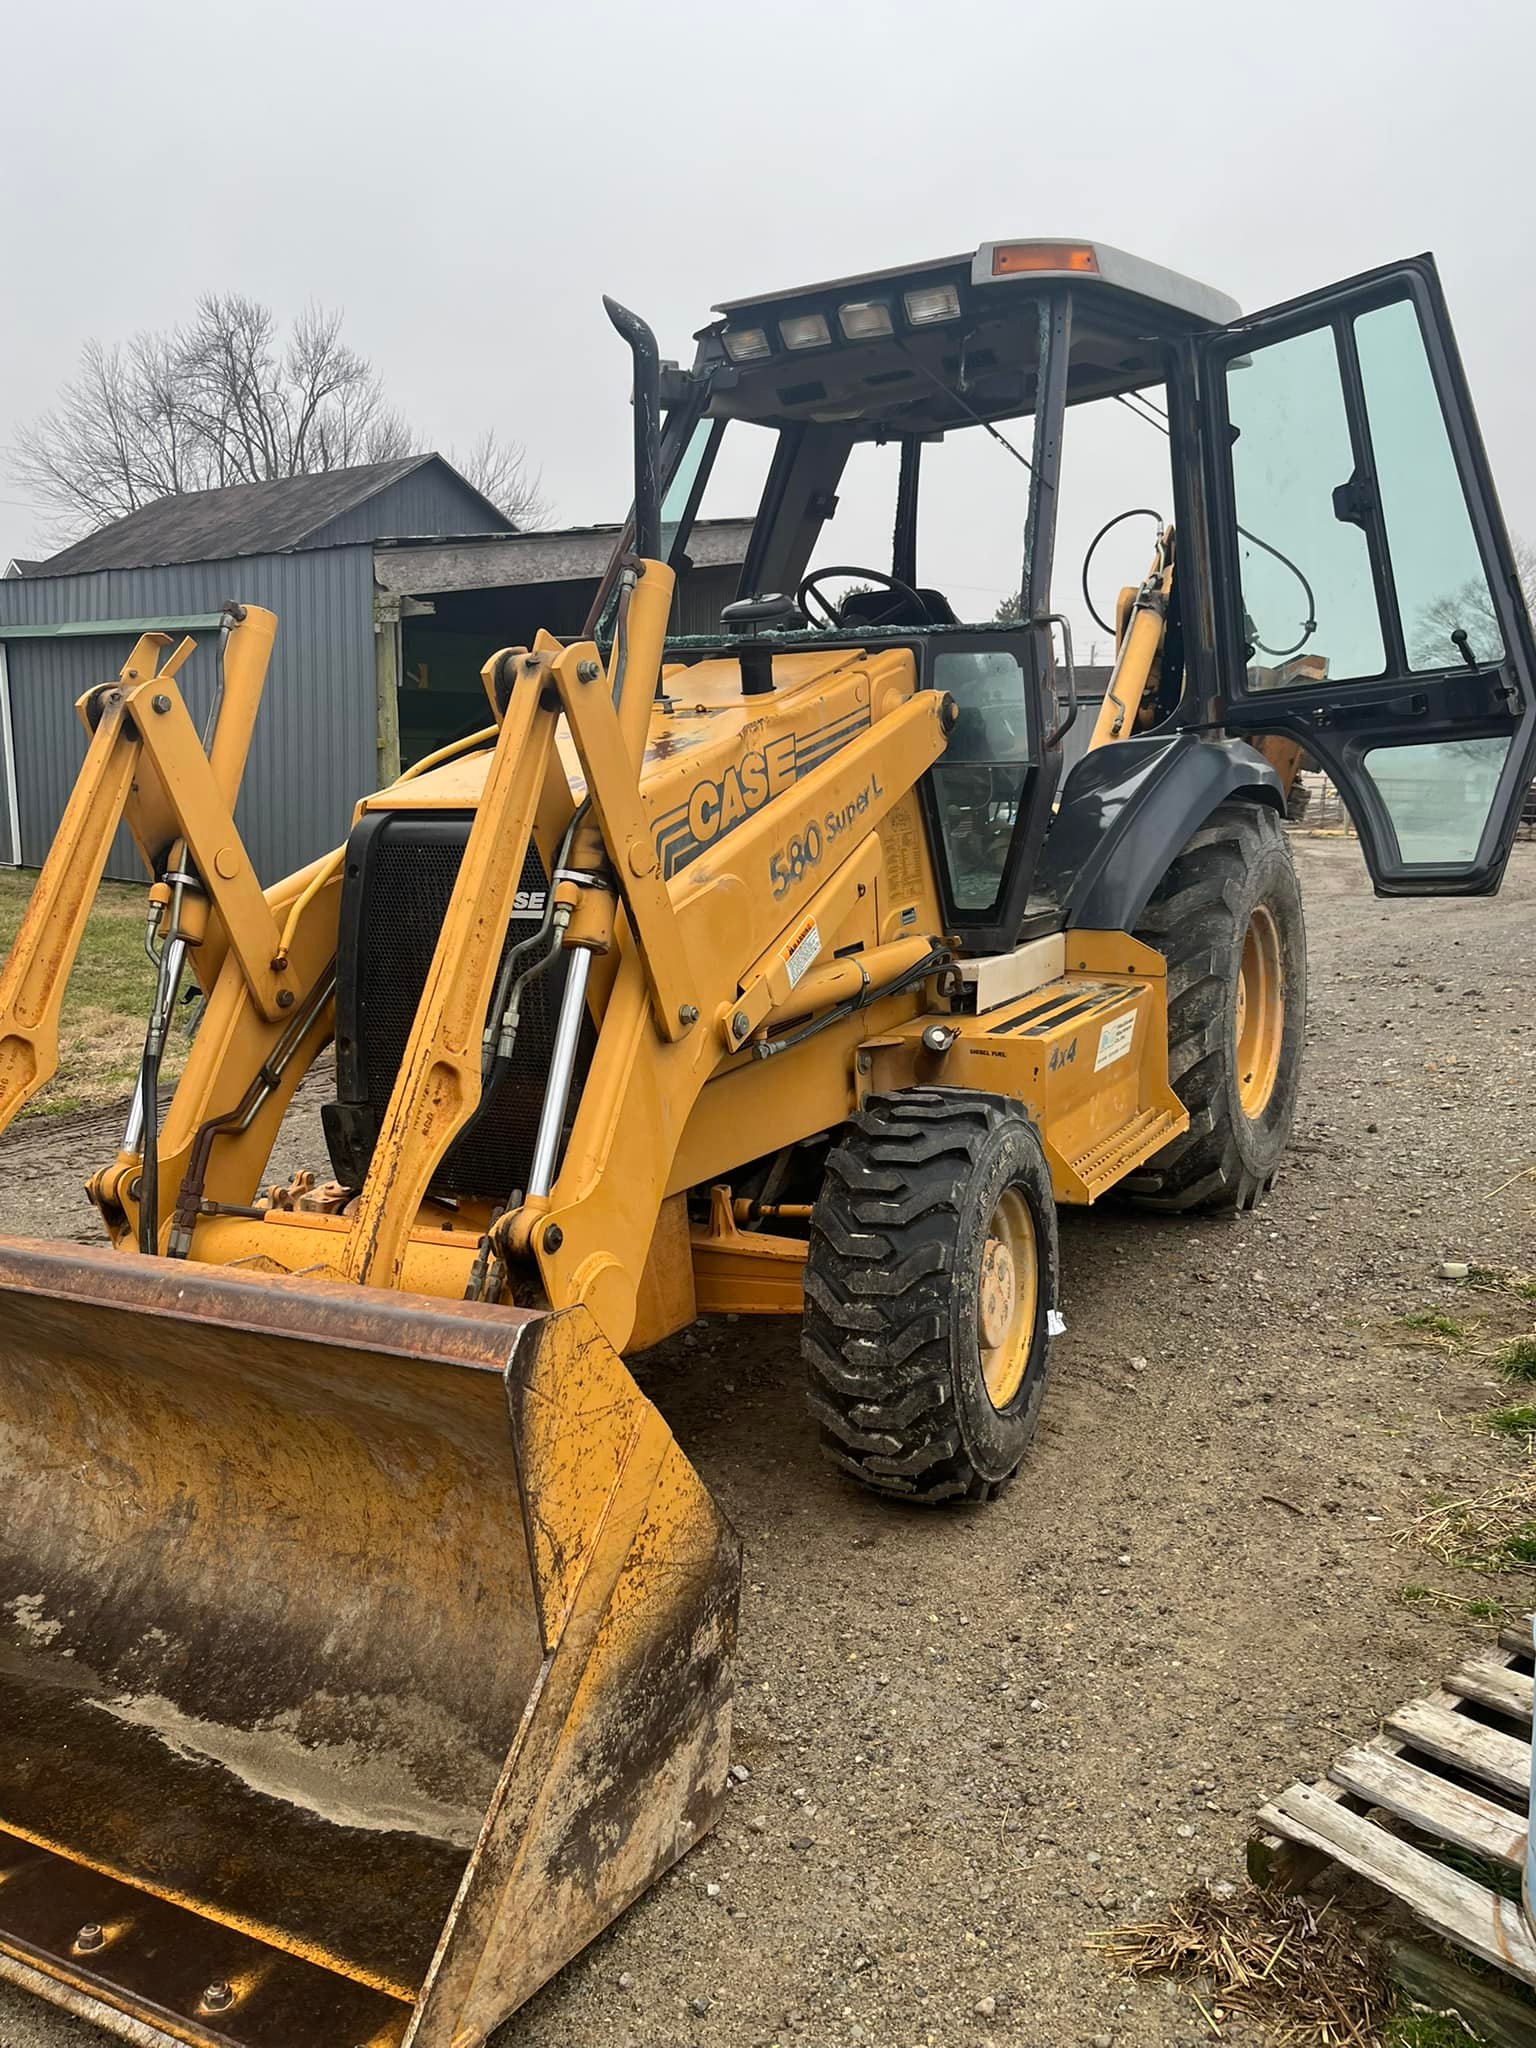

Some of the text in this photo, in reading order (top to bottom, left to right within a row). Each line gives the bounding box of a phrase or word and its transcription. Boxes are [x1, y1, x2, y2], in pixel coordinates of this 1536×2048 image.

[688, 733, 797, 842] CASE
[769, 819, 823, 901] 580
[824, 785, 870, 843] Super
[871, 772, 884, 798] L
[513, 891, 546, 909] SE
[991, 1050, 1007, 1058] FUEL
[1048, 1037, 1077, 1071] 4x4
